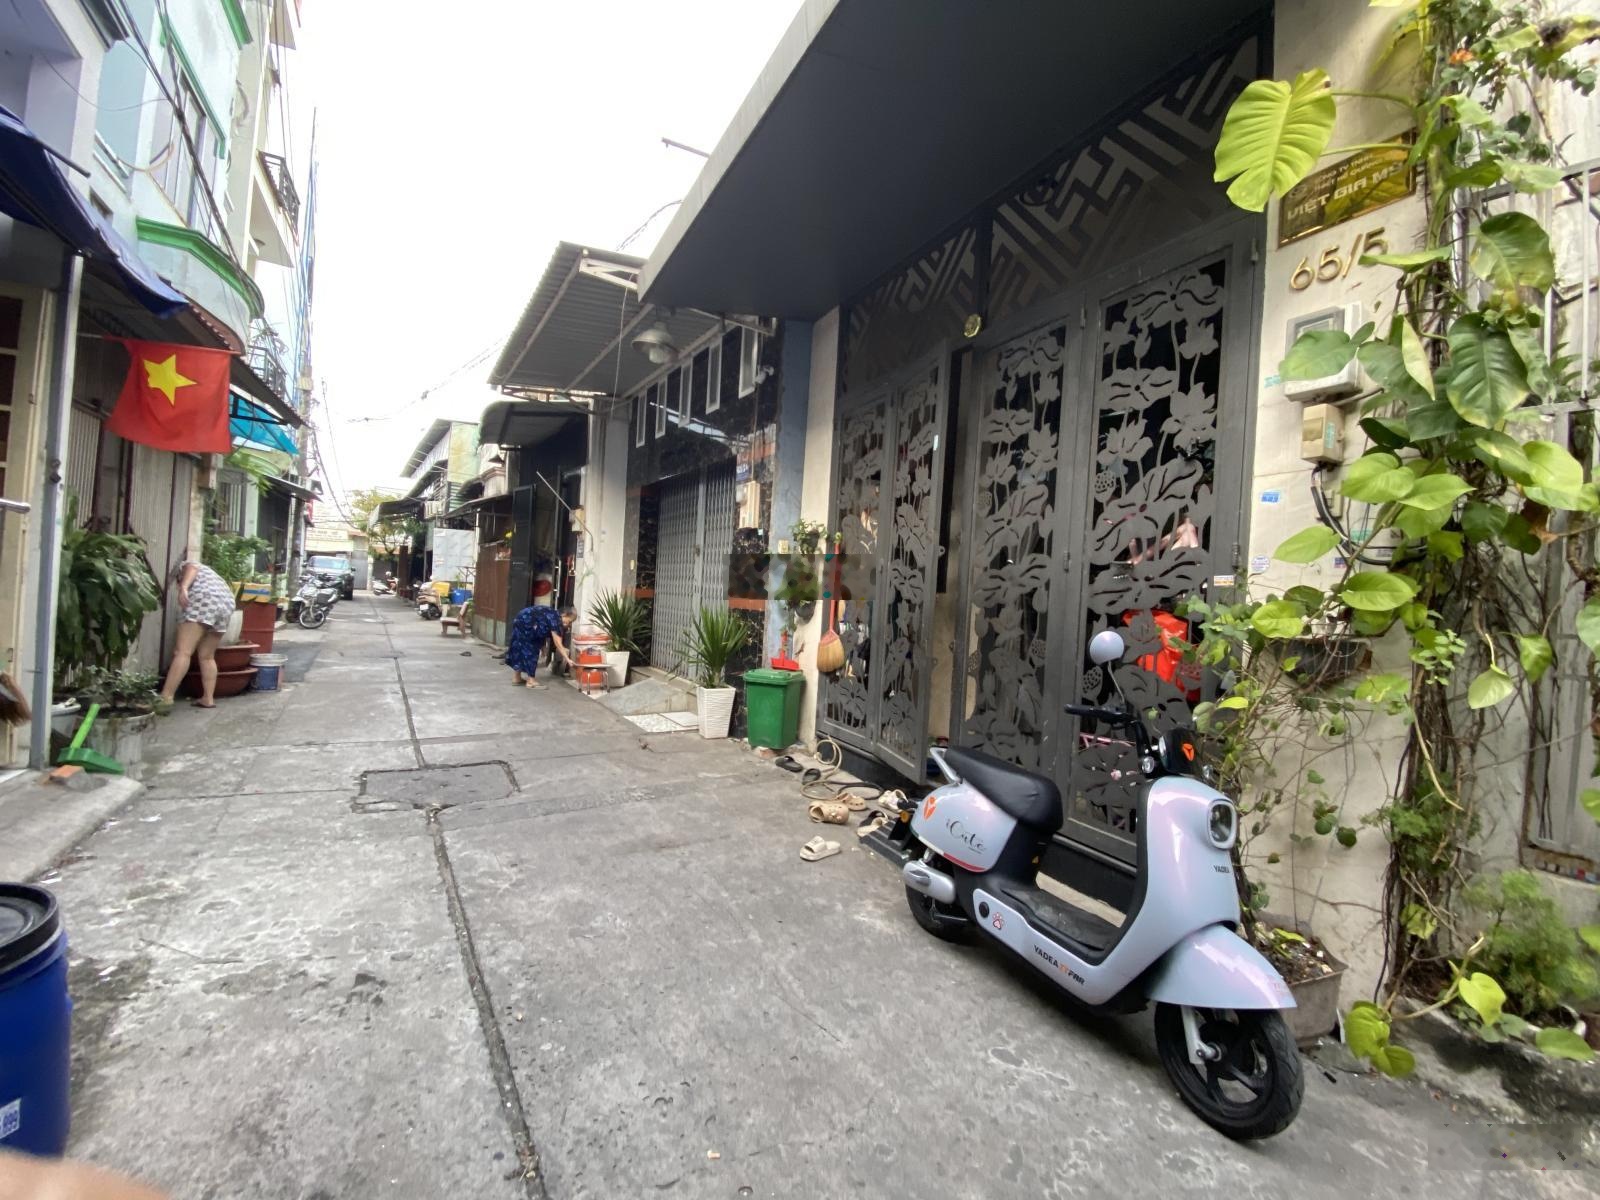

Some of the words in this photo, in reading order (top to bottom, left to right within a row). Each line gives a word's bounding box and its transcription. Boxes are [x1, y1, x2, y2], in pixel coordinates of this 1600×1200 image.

[1333, 176, 1367, 199] GIA
[1291, 227, 1388, 290] 65/5
[1033, 944, 1059, 968] YADEA
